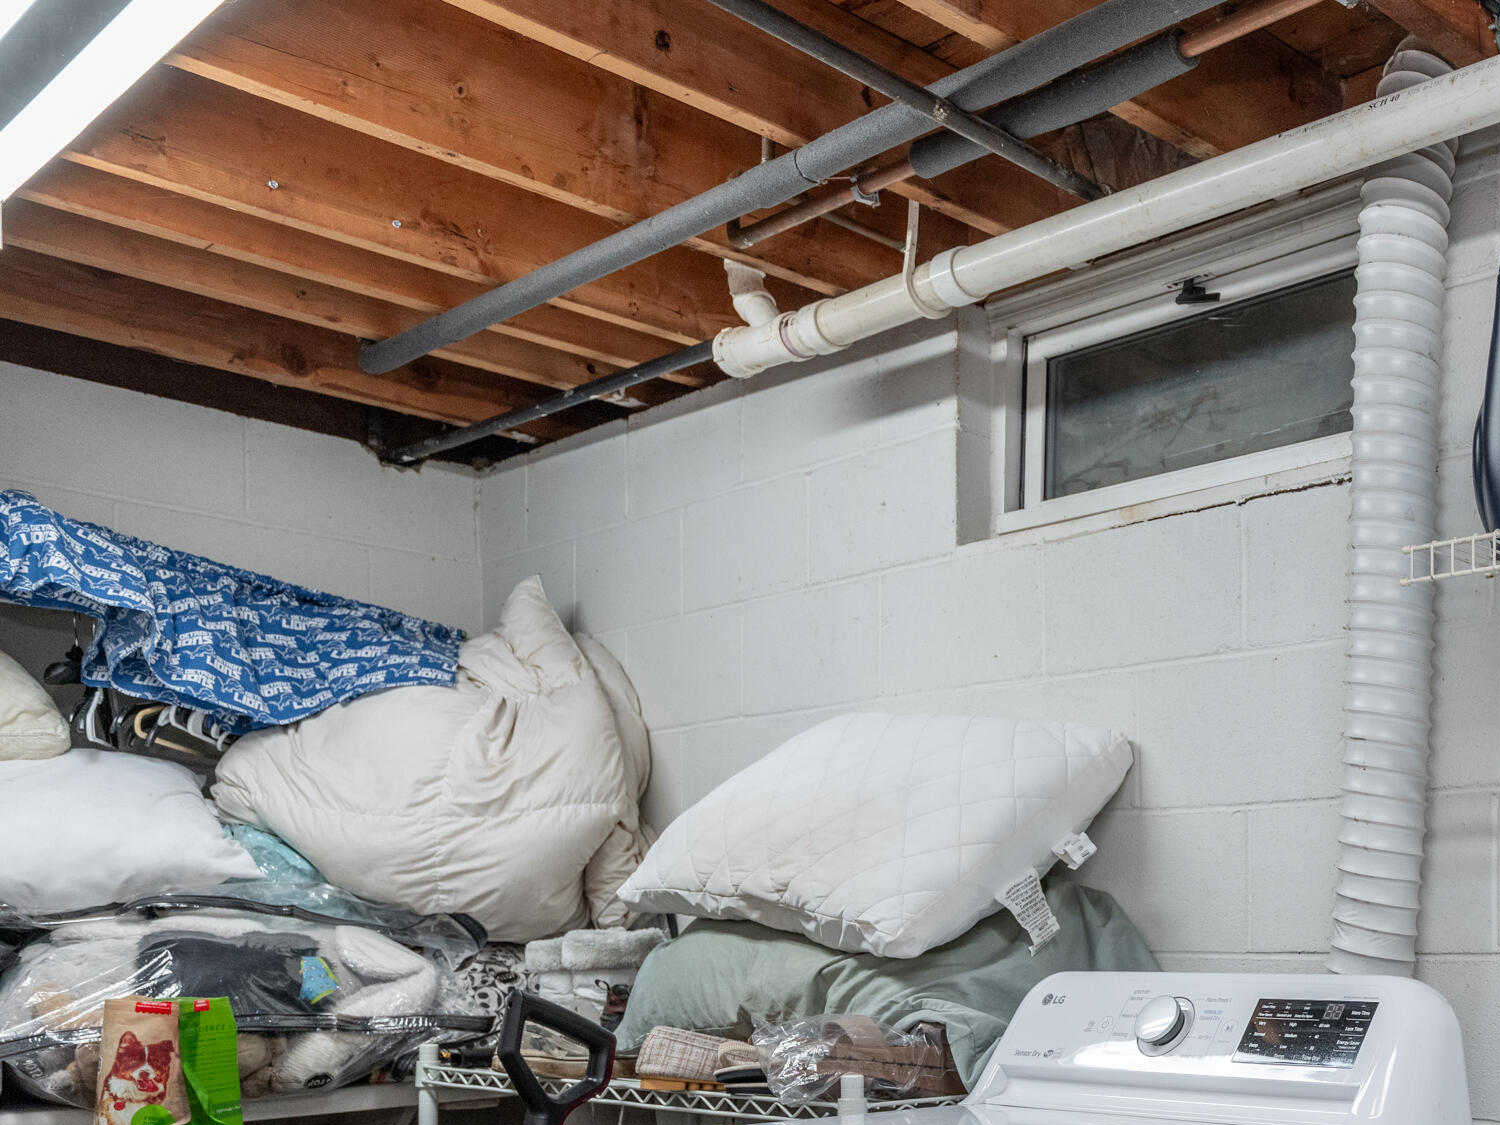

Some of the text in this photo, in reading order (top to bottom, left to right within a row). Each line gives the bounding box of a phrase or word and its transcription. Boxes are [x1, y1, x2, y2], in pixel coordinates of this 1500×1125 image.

[1367, 94, 1400, 111] SCH 40
[1052, 995, 1066, 1005] LG
